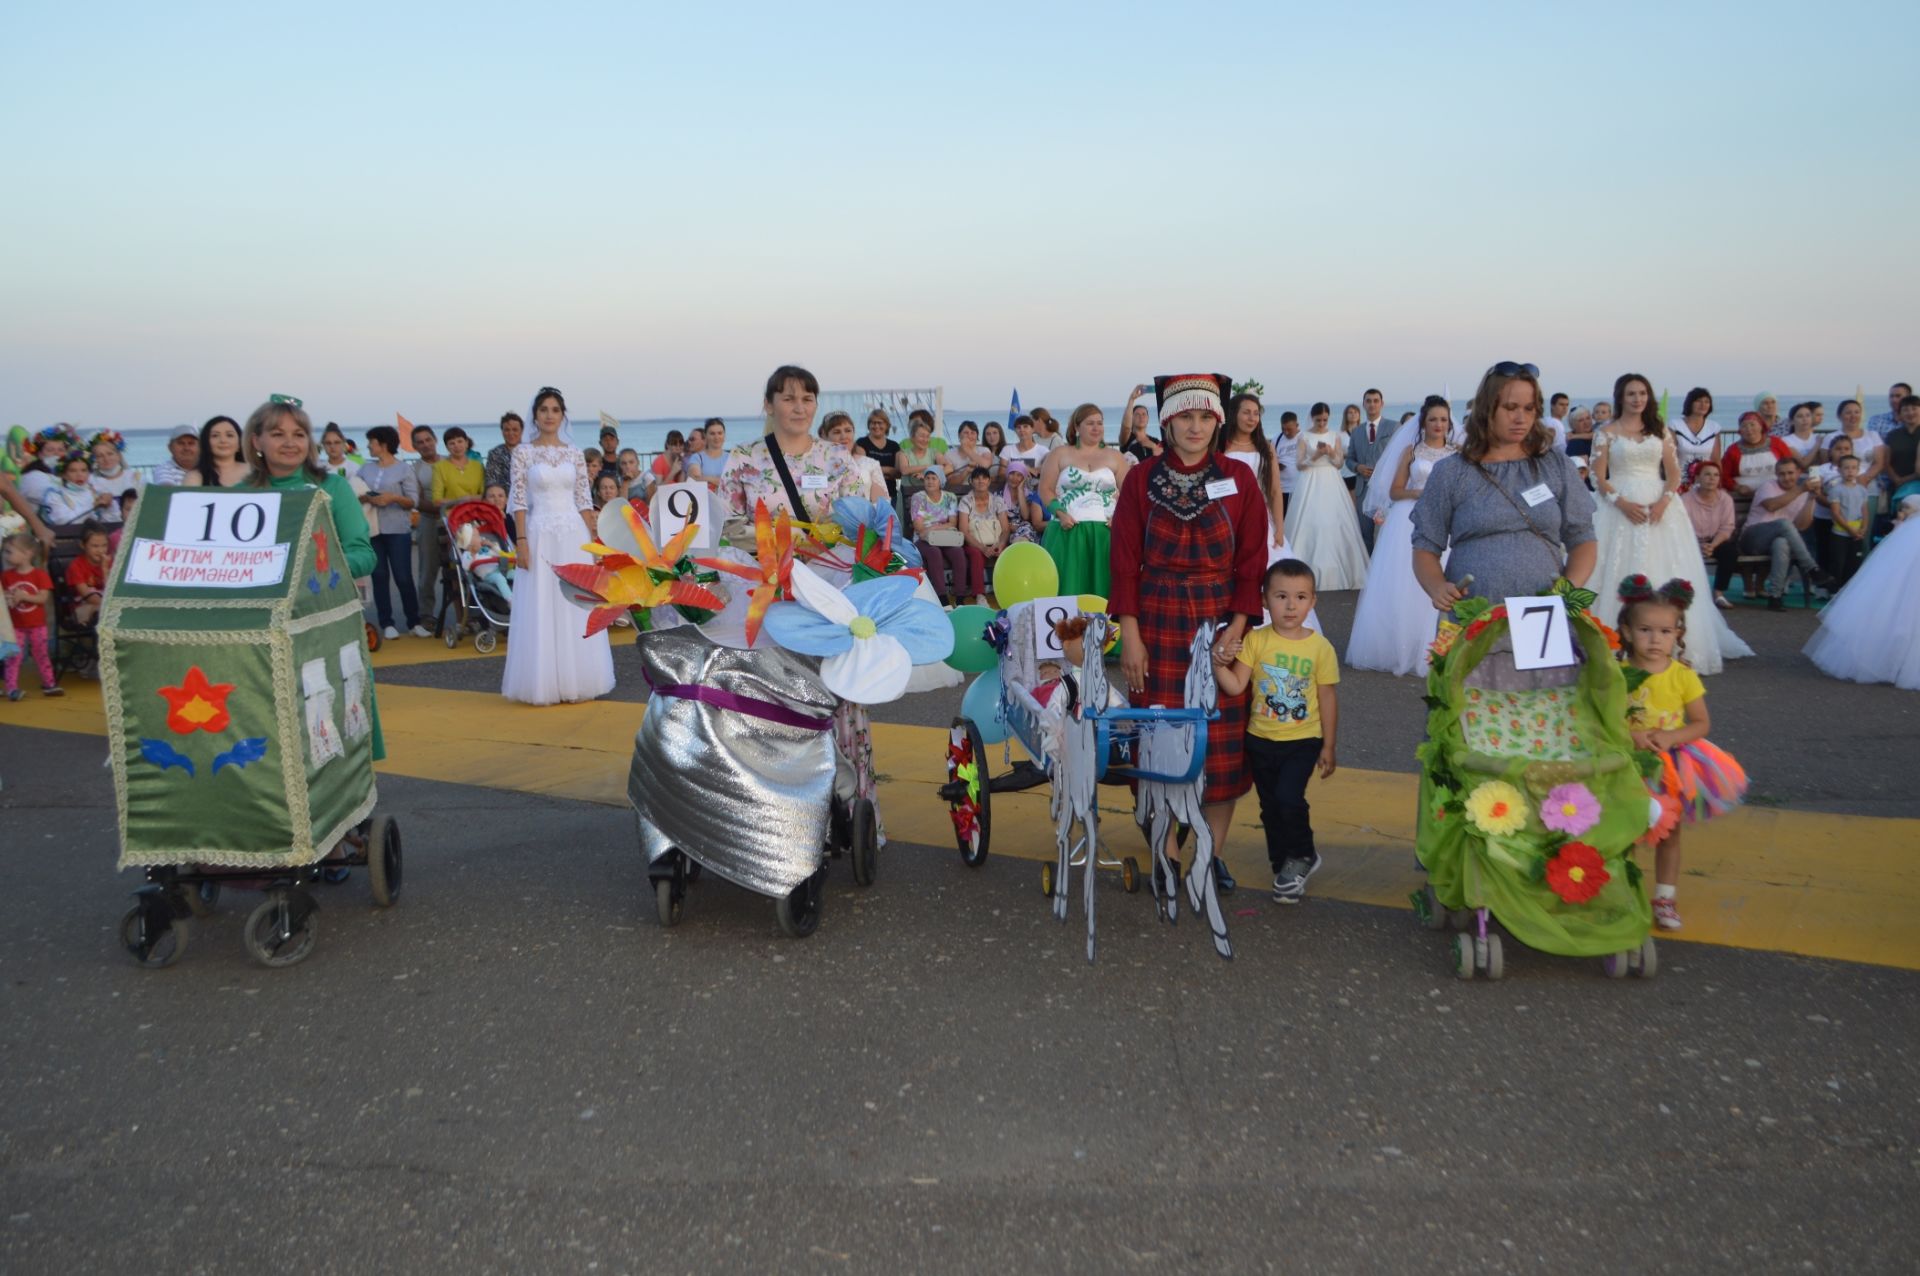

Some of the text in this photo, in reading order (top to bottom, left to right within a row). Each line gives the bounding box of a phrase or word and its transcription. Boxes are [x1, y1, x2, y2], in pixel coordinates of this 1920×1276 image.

[195, 502, 266, 543] 10
[667, 488, 699, 537] 9
[1045, 606, 1069, 651] 8
[1521, 605, 1555, 659] 7
[1275, 652, 1313, 677] BIG
